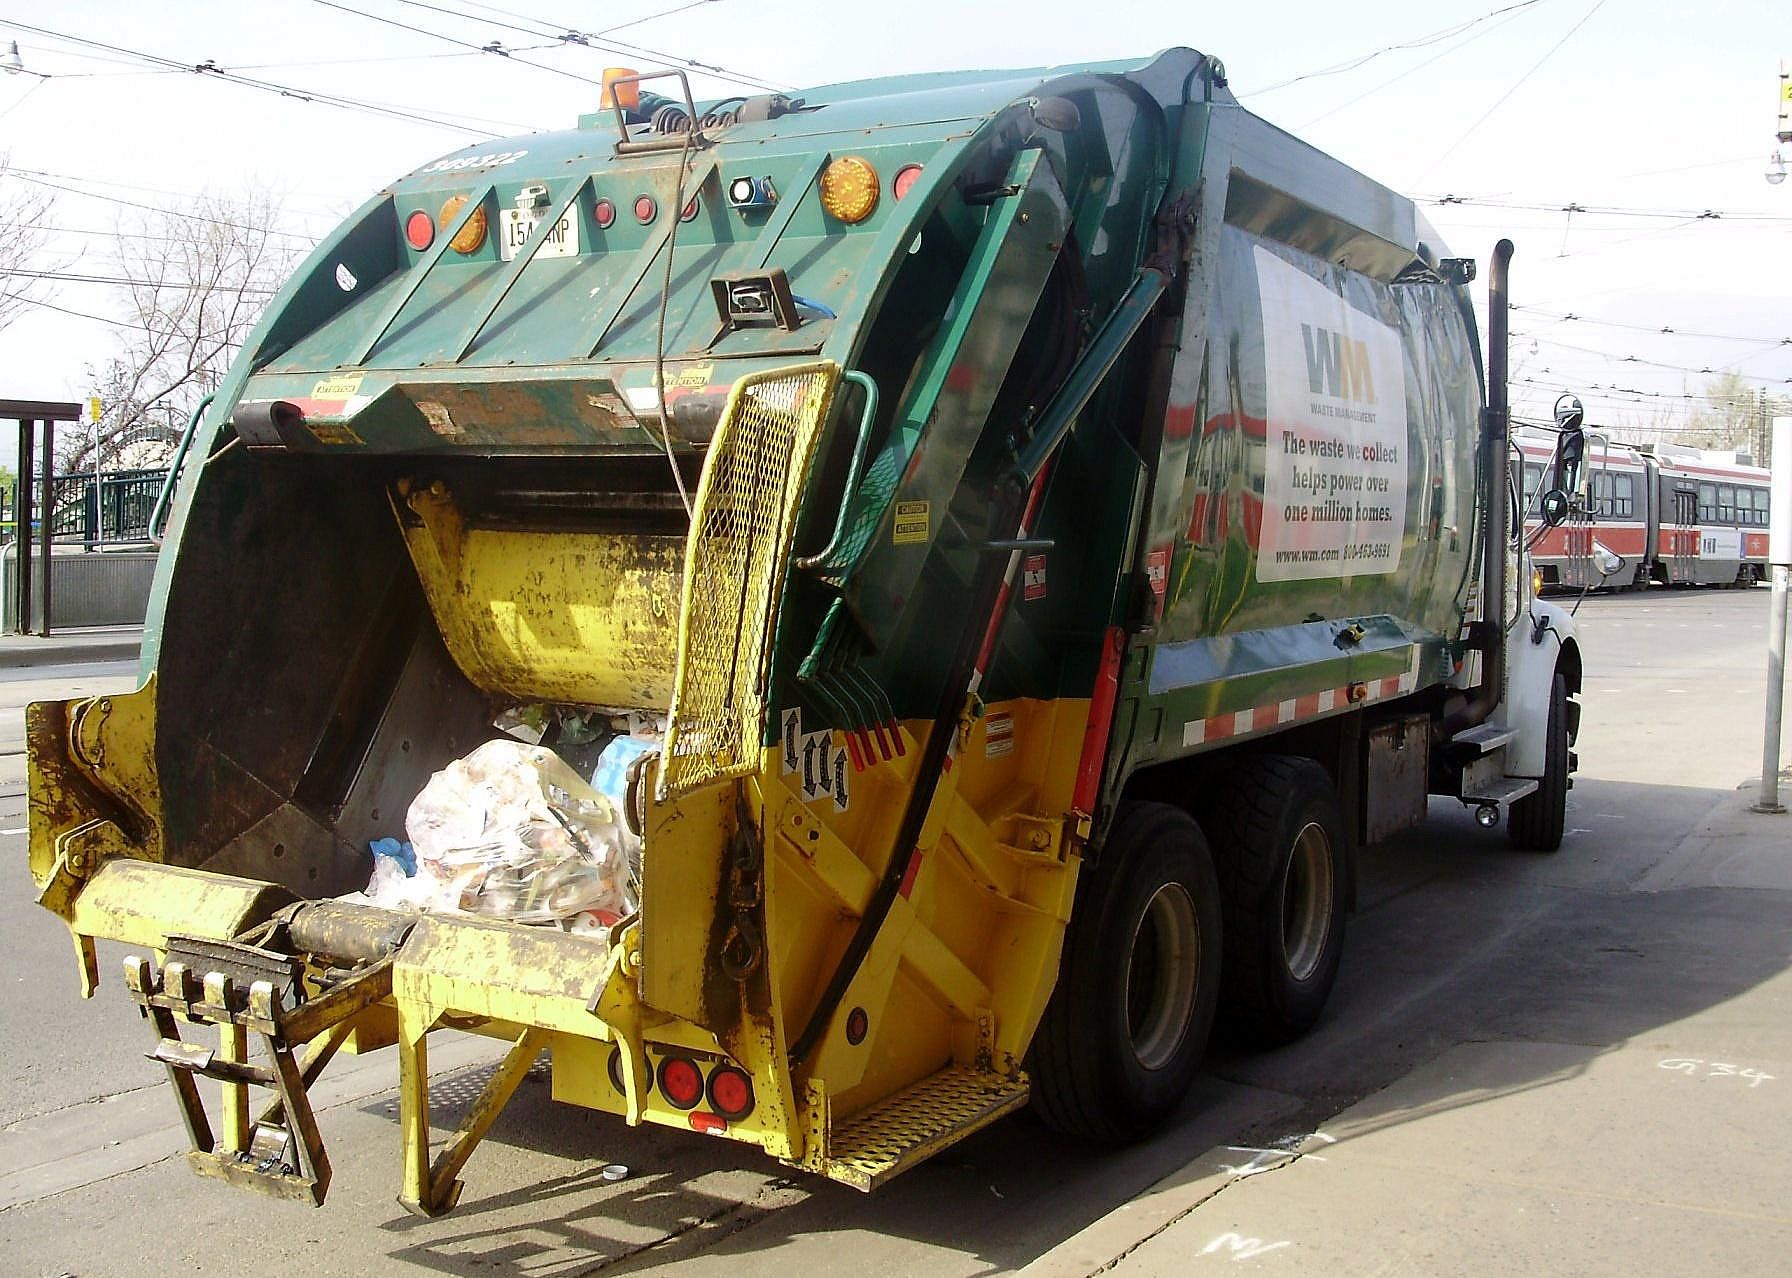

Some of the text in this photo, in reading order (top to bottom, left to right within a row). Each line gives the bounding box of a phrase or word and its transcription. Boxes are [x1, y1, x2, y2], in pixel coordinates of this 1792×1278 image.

[1300, 322, 1377, 405] WM
[1310, 402, 1377, 424] WASTE MANAGEMENT
[1282, 430, 1398, 464] The waste we collect
[1291, 464, 1389, 497] helps power over
[1284, 500, 1393, 522] one million homes.
[1275, 549, 1339, 563] www.wm.com
